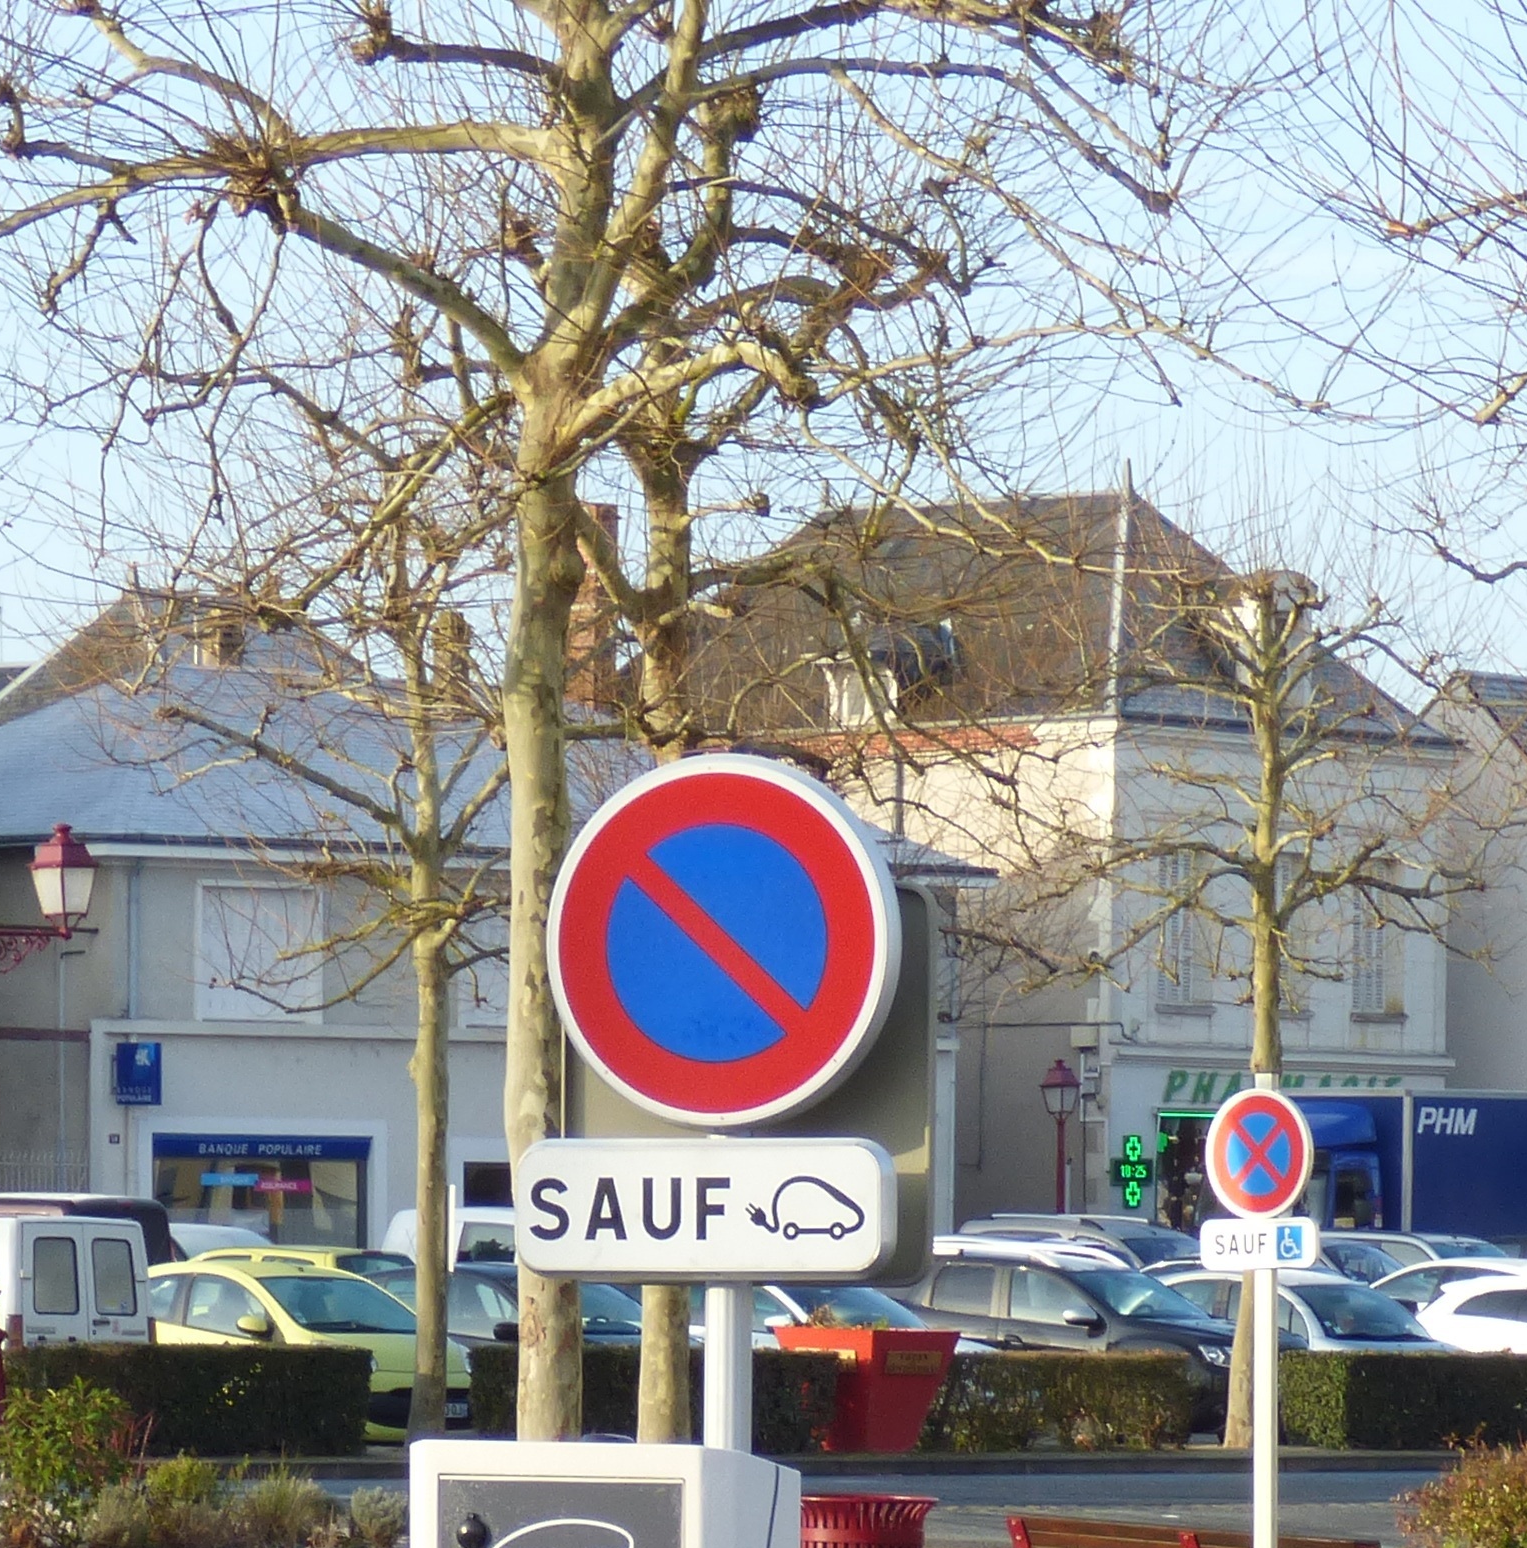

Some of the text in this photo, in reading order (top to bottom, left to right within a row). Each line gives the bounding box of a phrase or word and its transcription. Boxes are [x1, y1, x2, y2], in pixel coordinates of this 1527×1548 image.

[1417, 1107, 1478, 1135] PHM
[198, 1143, 323, 1155] BANQUE POPULAIRE
[1120, 1164, 1147, 1178] 10:25
[529, 1176, 731, 1241] SAUF
[1215, 1233, 1267, 1255] SAUF
